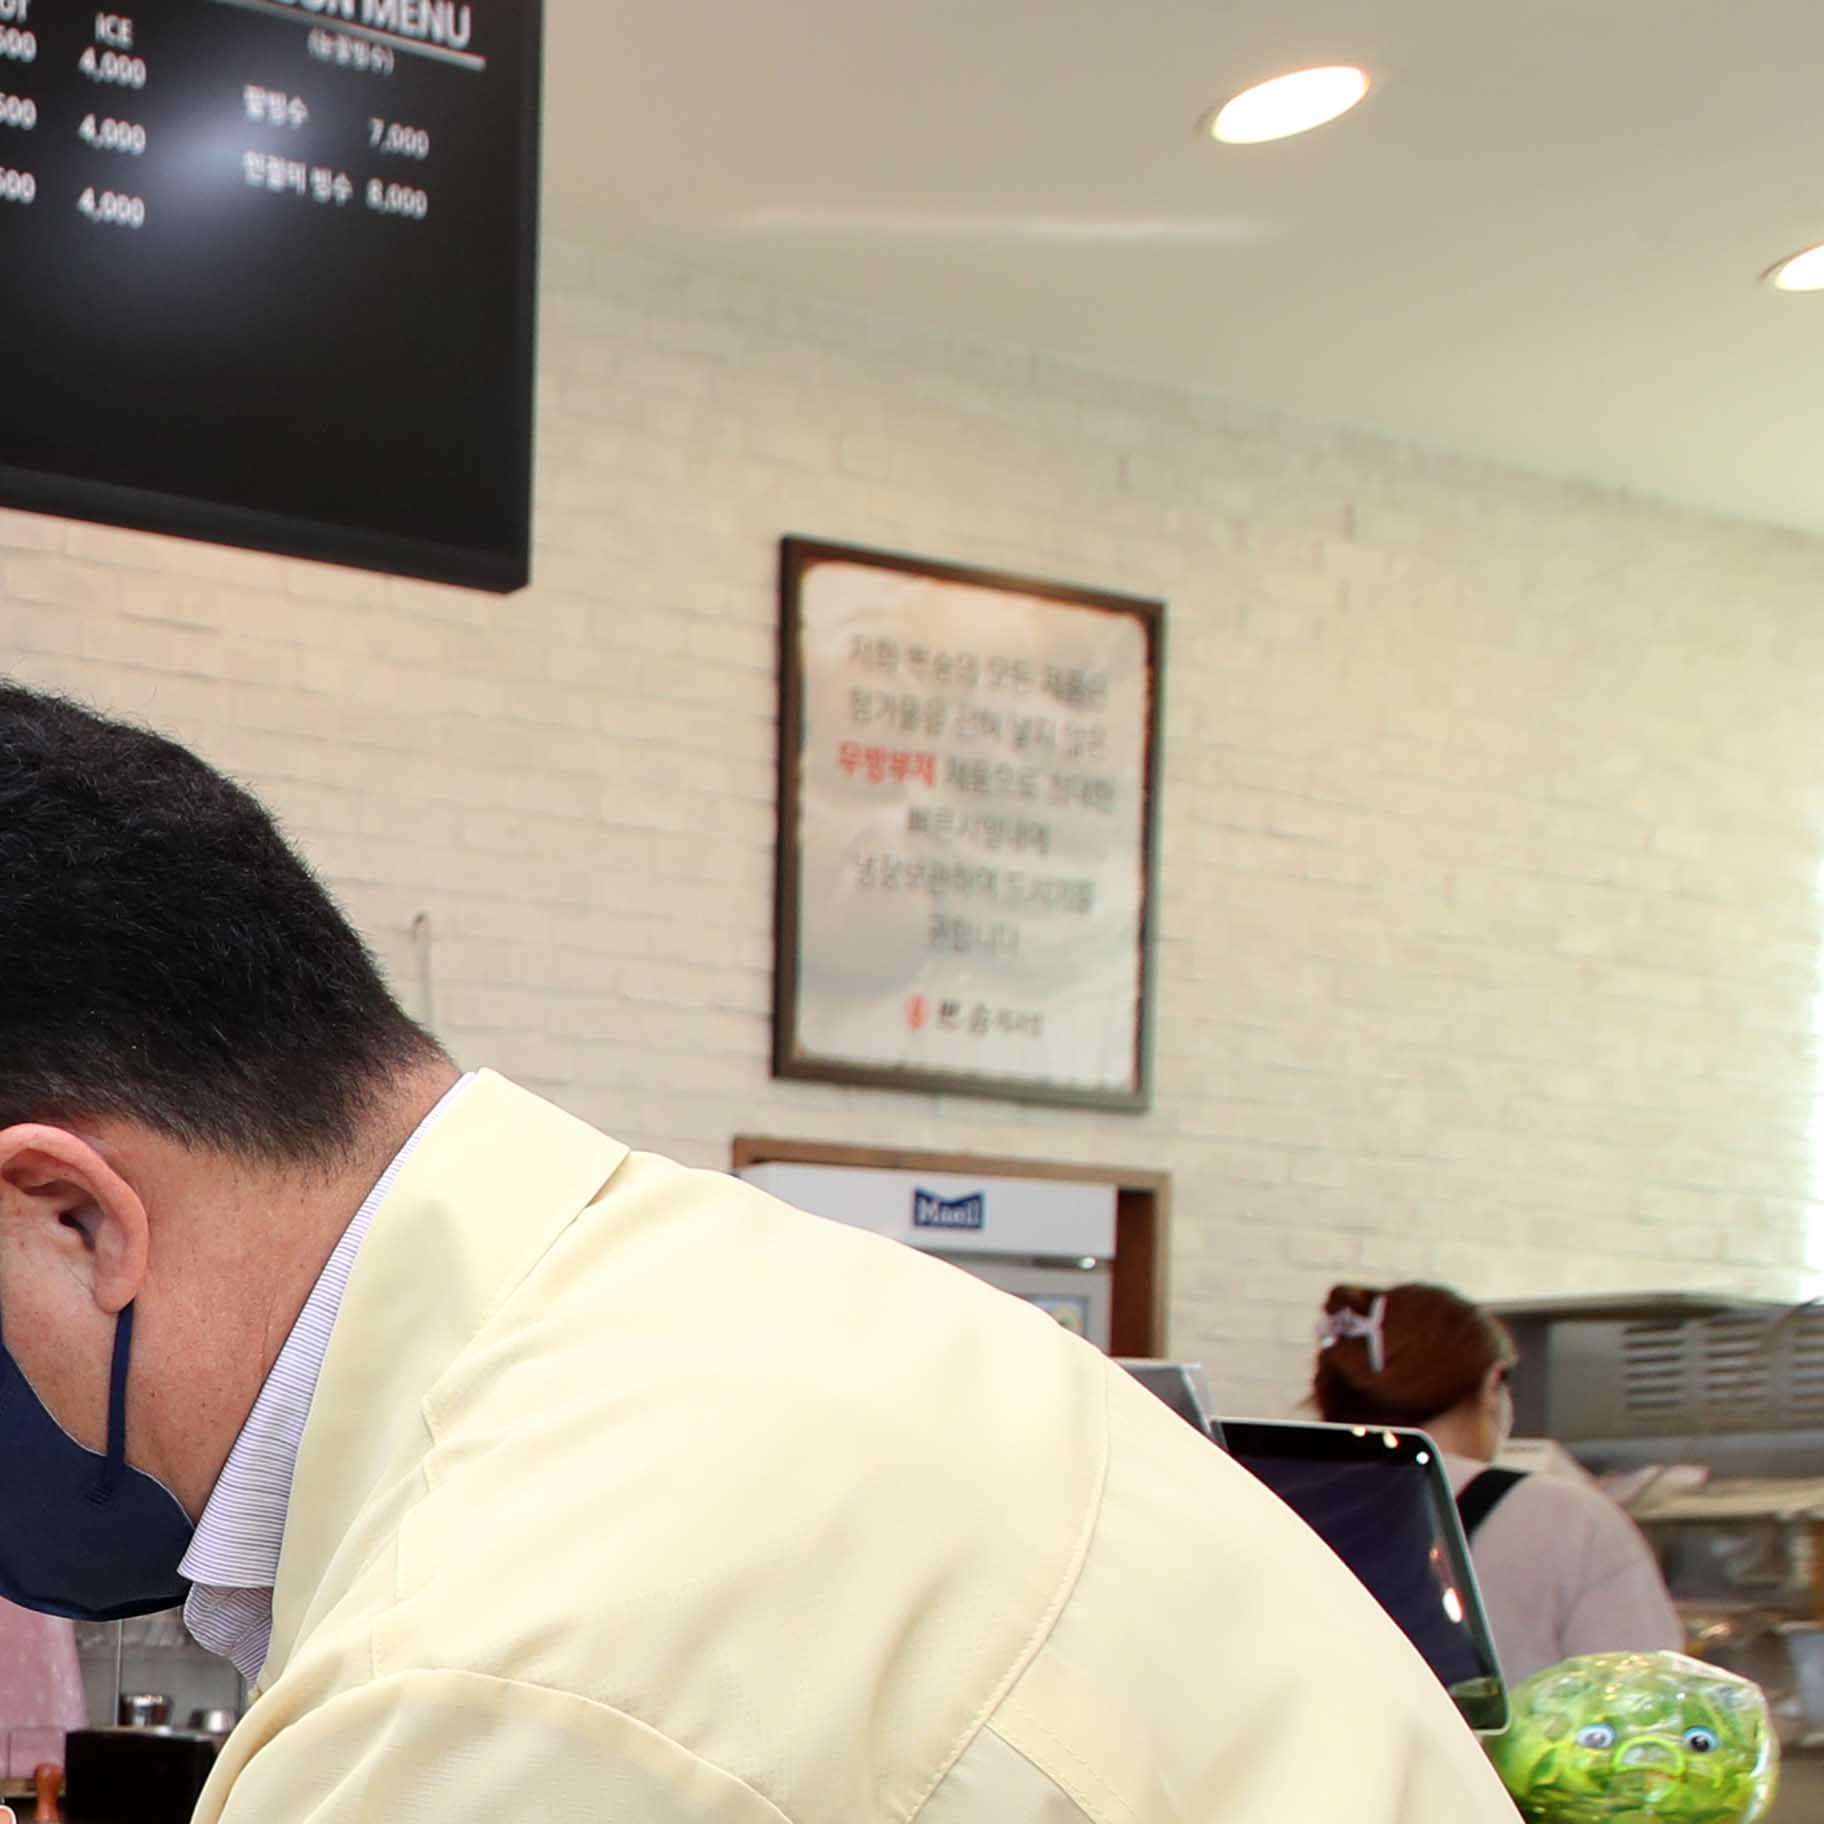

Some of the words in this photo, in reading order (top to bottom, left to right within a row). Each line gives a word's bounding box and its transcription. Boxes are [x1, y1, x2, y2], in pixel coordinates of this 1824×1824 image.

[96, 12, 133, 49] ICE
[361, 0, 471, 48] MENU
[79, 46, 147, 89] 4,000
[79, 113, 146, 155] 4,000
[368, 117, 430, 160] 7,000
[77, 187, 145, 229] 4,000
